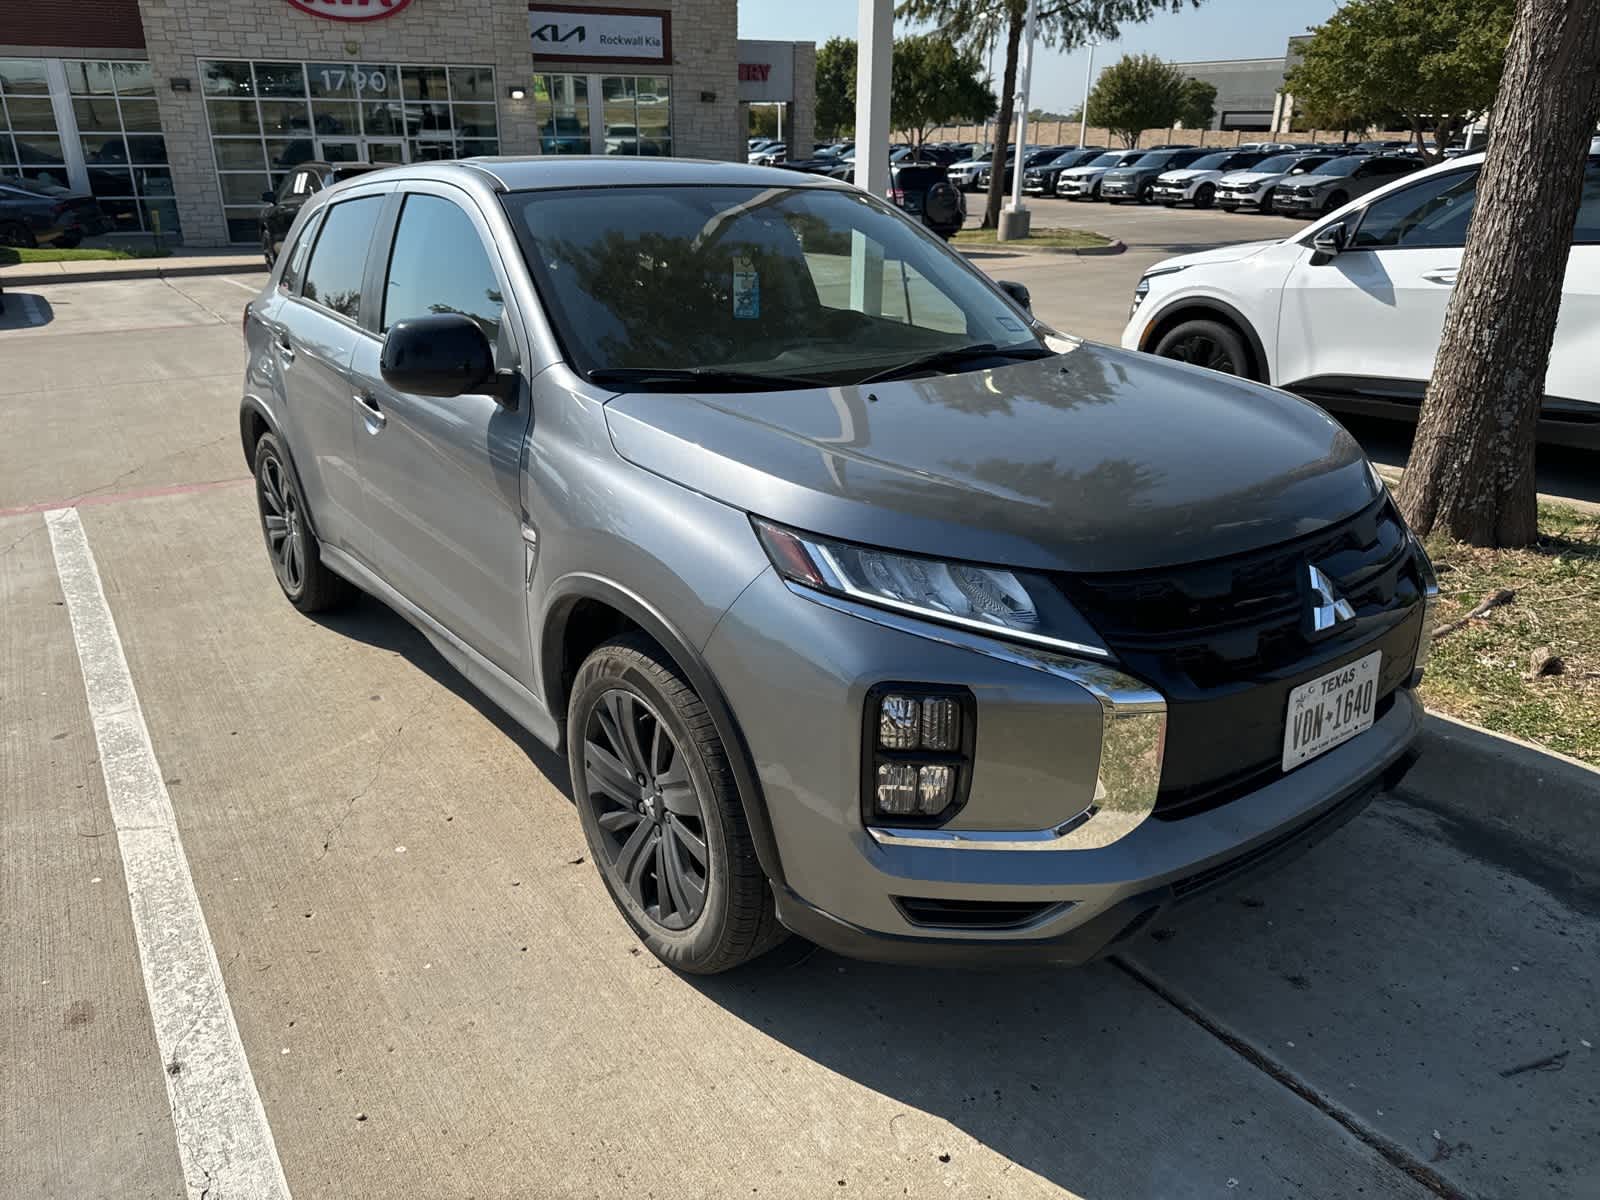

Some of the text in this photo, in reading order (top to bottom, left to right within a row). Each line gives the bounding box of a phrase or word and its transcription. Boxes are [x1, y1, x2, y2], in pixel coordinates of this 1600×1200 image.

[600, 34, 661, 47] Rockwall Kia
[320, 69, 386, 93] 1790
[1321, 668, 1355, 696] TEXAS
